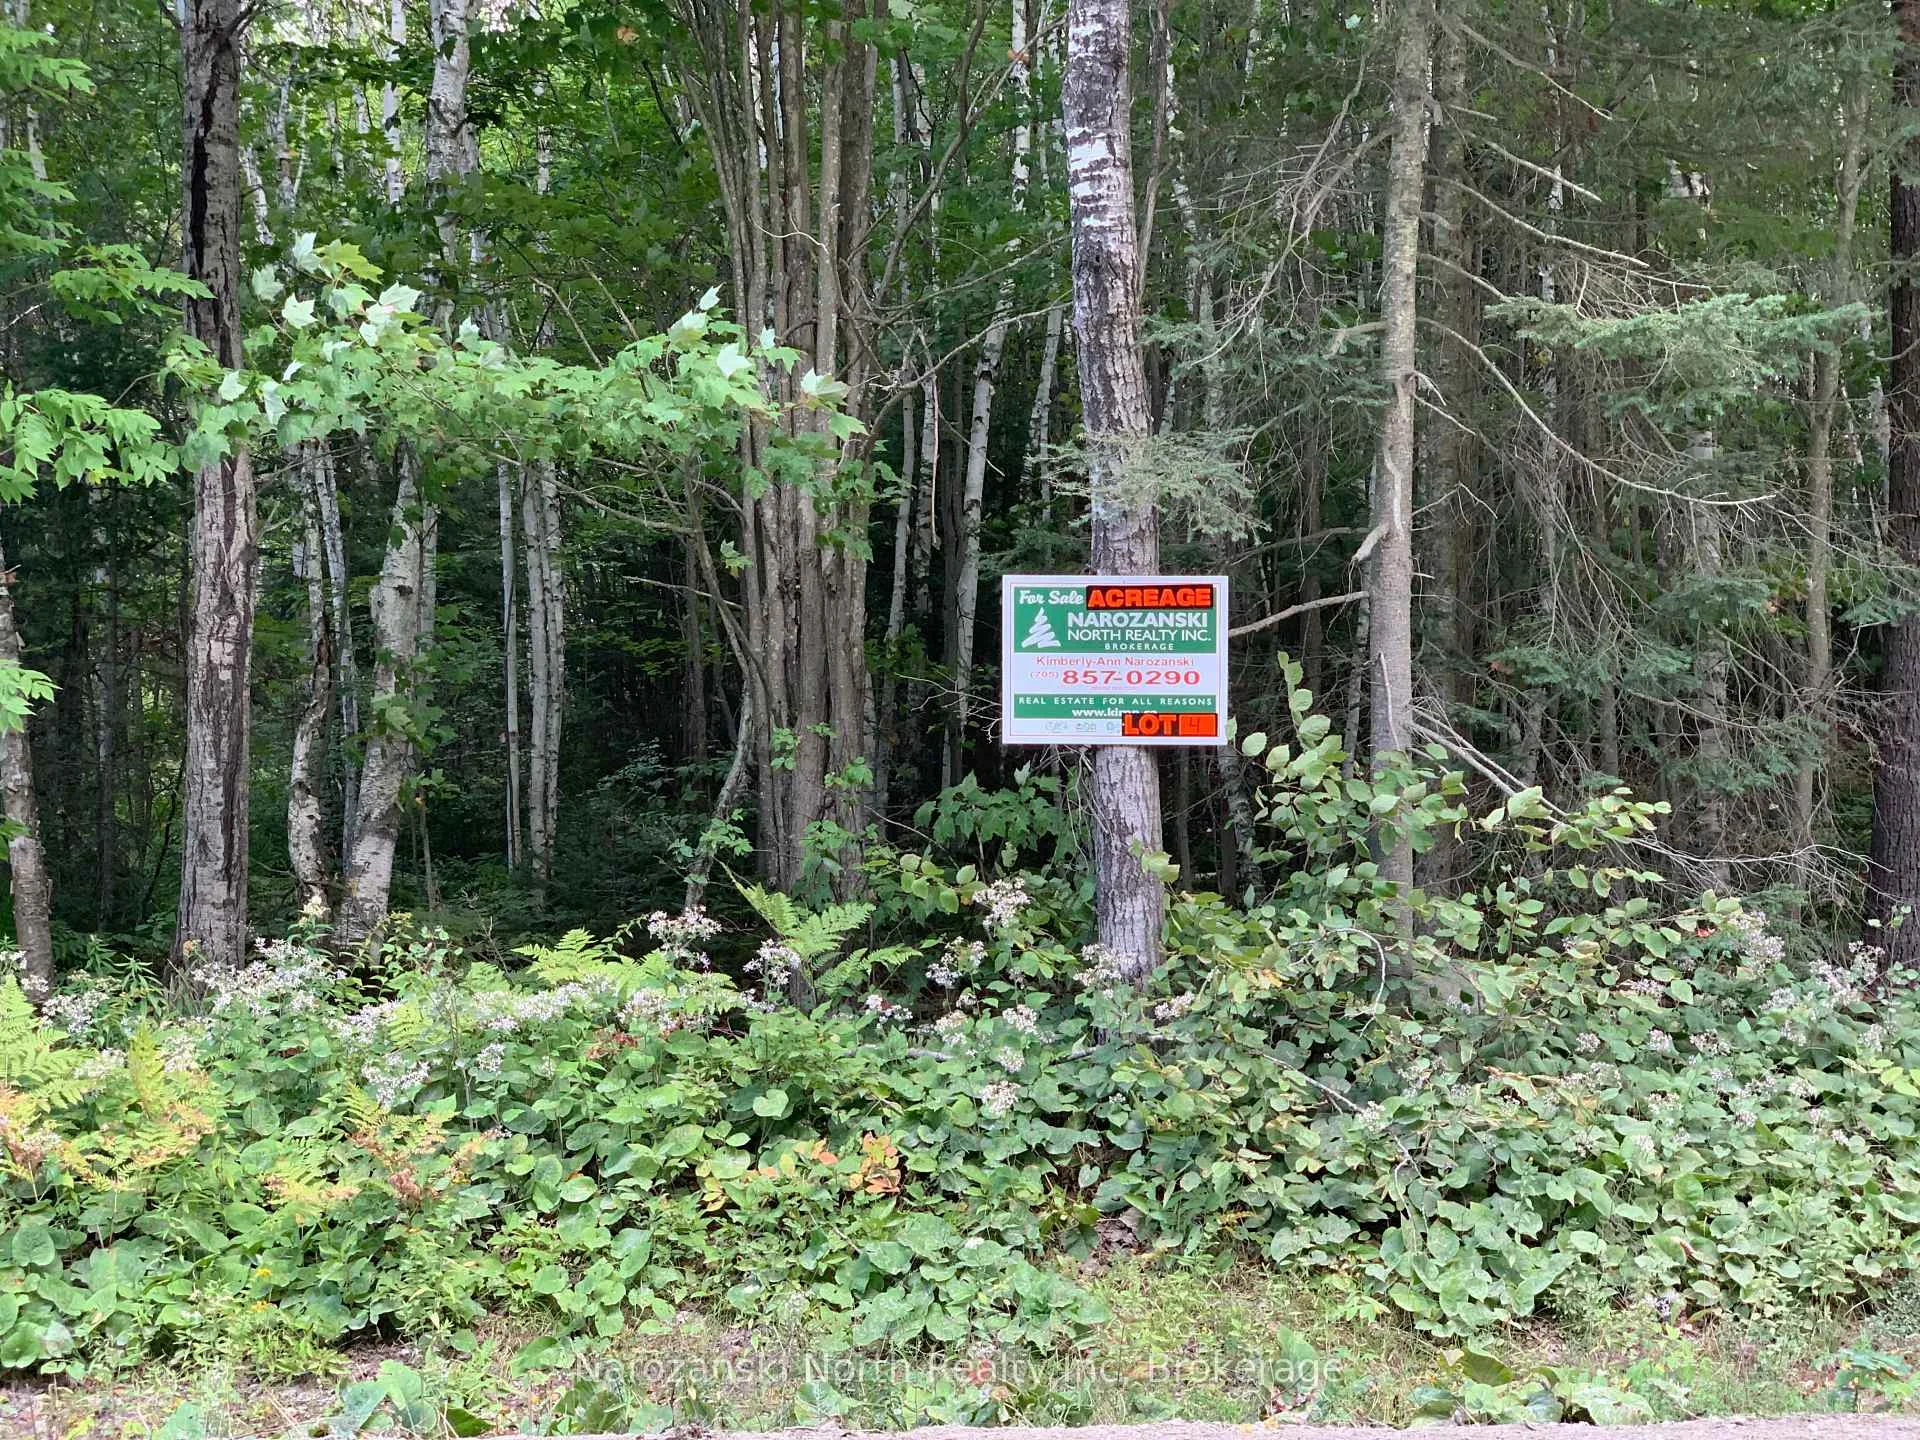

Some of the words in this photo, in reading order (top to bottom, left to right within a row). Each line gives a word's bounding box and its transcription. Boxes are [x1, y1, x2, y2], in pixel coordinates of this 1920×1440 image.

[1019, 590, 1044, 604] For
[1049, 590, 1083, 605] Sale
[1088, 589, 1211, 607] ACREAGE
[1067, 612, 1208, 627] NAROZANSKI
[1067, 629, 1121, 641] NORTH
[1125, 629, 1178, 641] REALTY
[1181, 629, 1211, 641] INC.
[1036, 656, 1120, 668] Kimberly-Ann
[1125, 656, 1194, 666] Narozanski
[1062, 670, 1200, 685] 857-0290
[1018, 697, 1046, 705] REAL
[1054, 697, 1095, 705] ESTATE
[1102, 697, 1124, 705] FOR
[1131, 697, 1152, 705] ALL
[1160, 697, 1212, 706] REASONS
[1124, 714, 1176, 735] LOT
